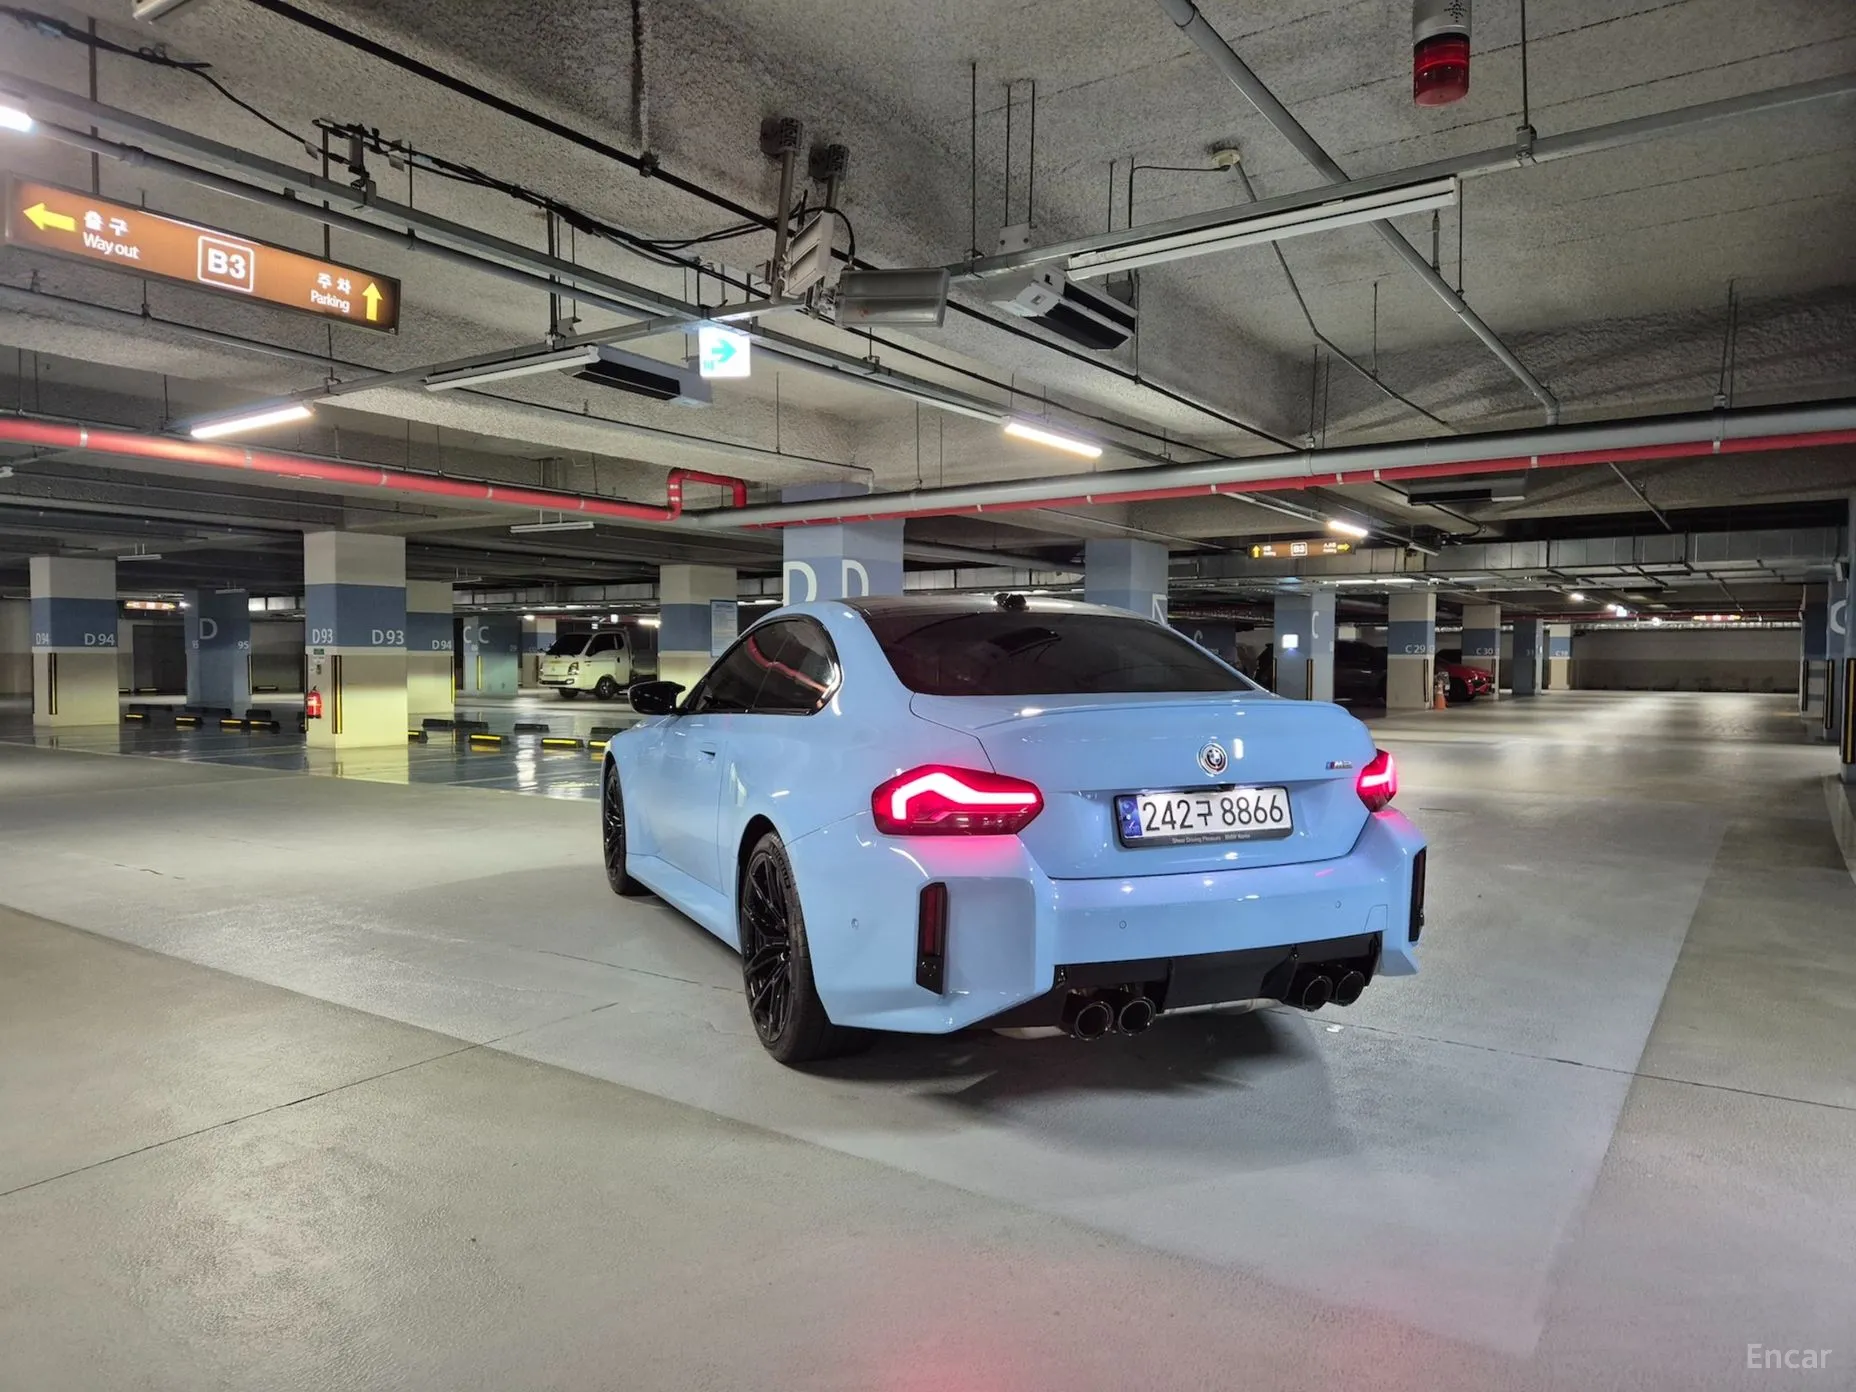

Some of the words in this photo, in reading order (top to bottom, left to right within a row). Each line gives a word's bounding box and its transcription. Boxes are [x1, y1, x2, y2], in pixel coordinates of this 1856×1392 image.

[83, 231, 114, 255] Way
[115, 243, 141, 261] out
[208, 247, 246, 279] B3
[311, 289, 350, 313] Parking
[200, 618, 217, 639] D
[479, 626, 489, 644] C
[238, 641, 249, 649] 95
[1220, 795, 1284, 826] 8866
